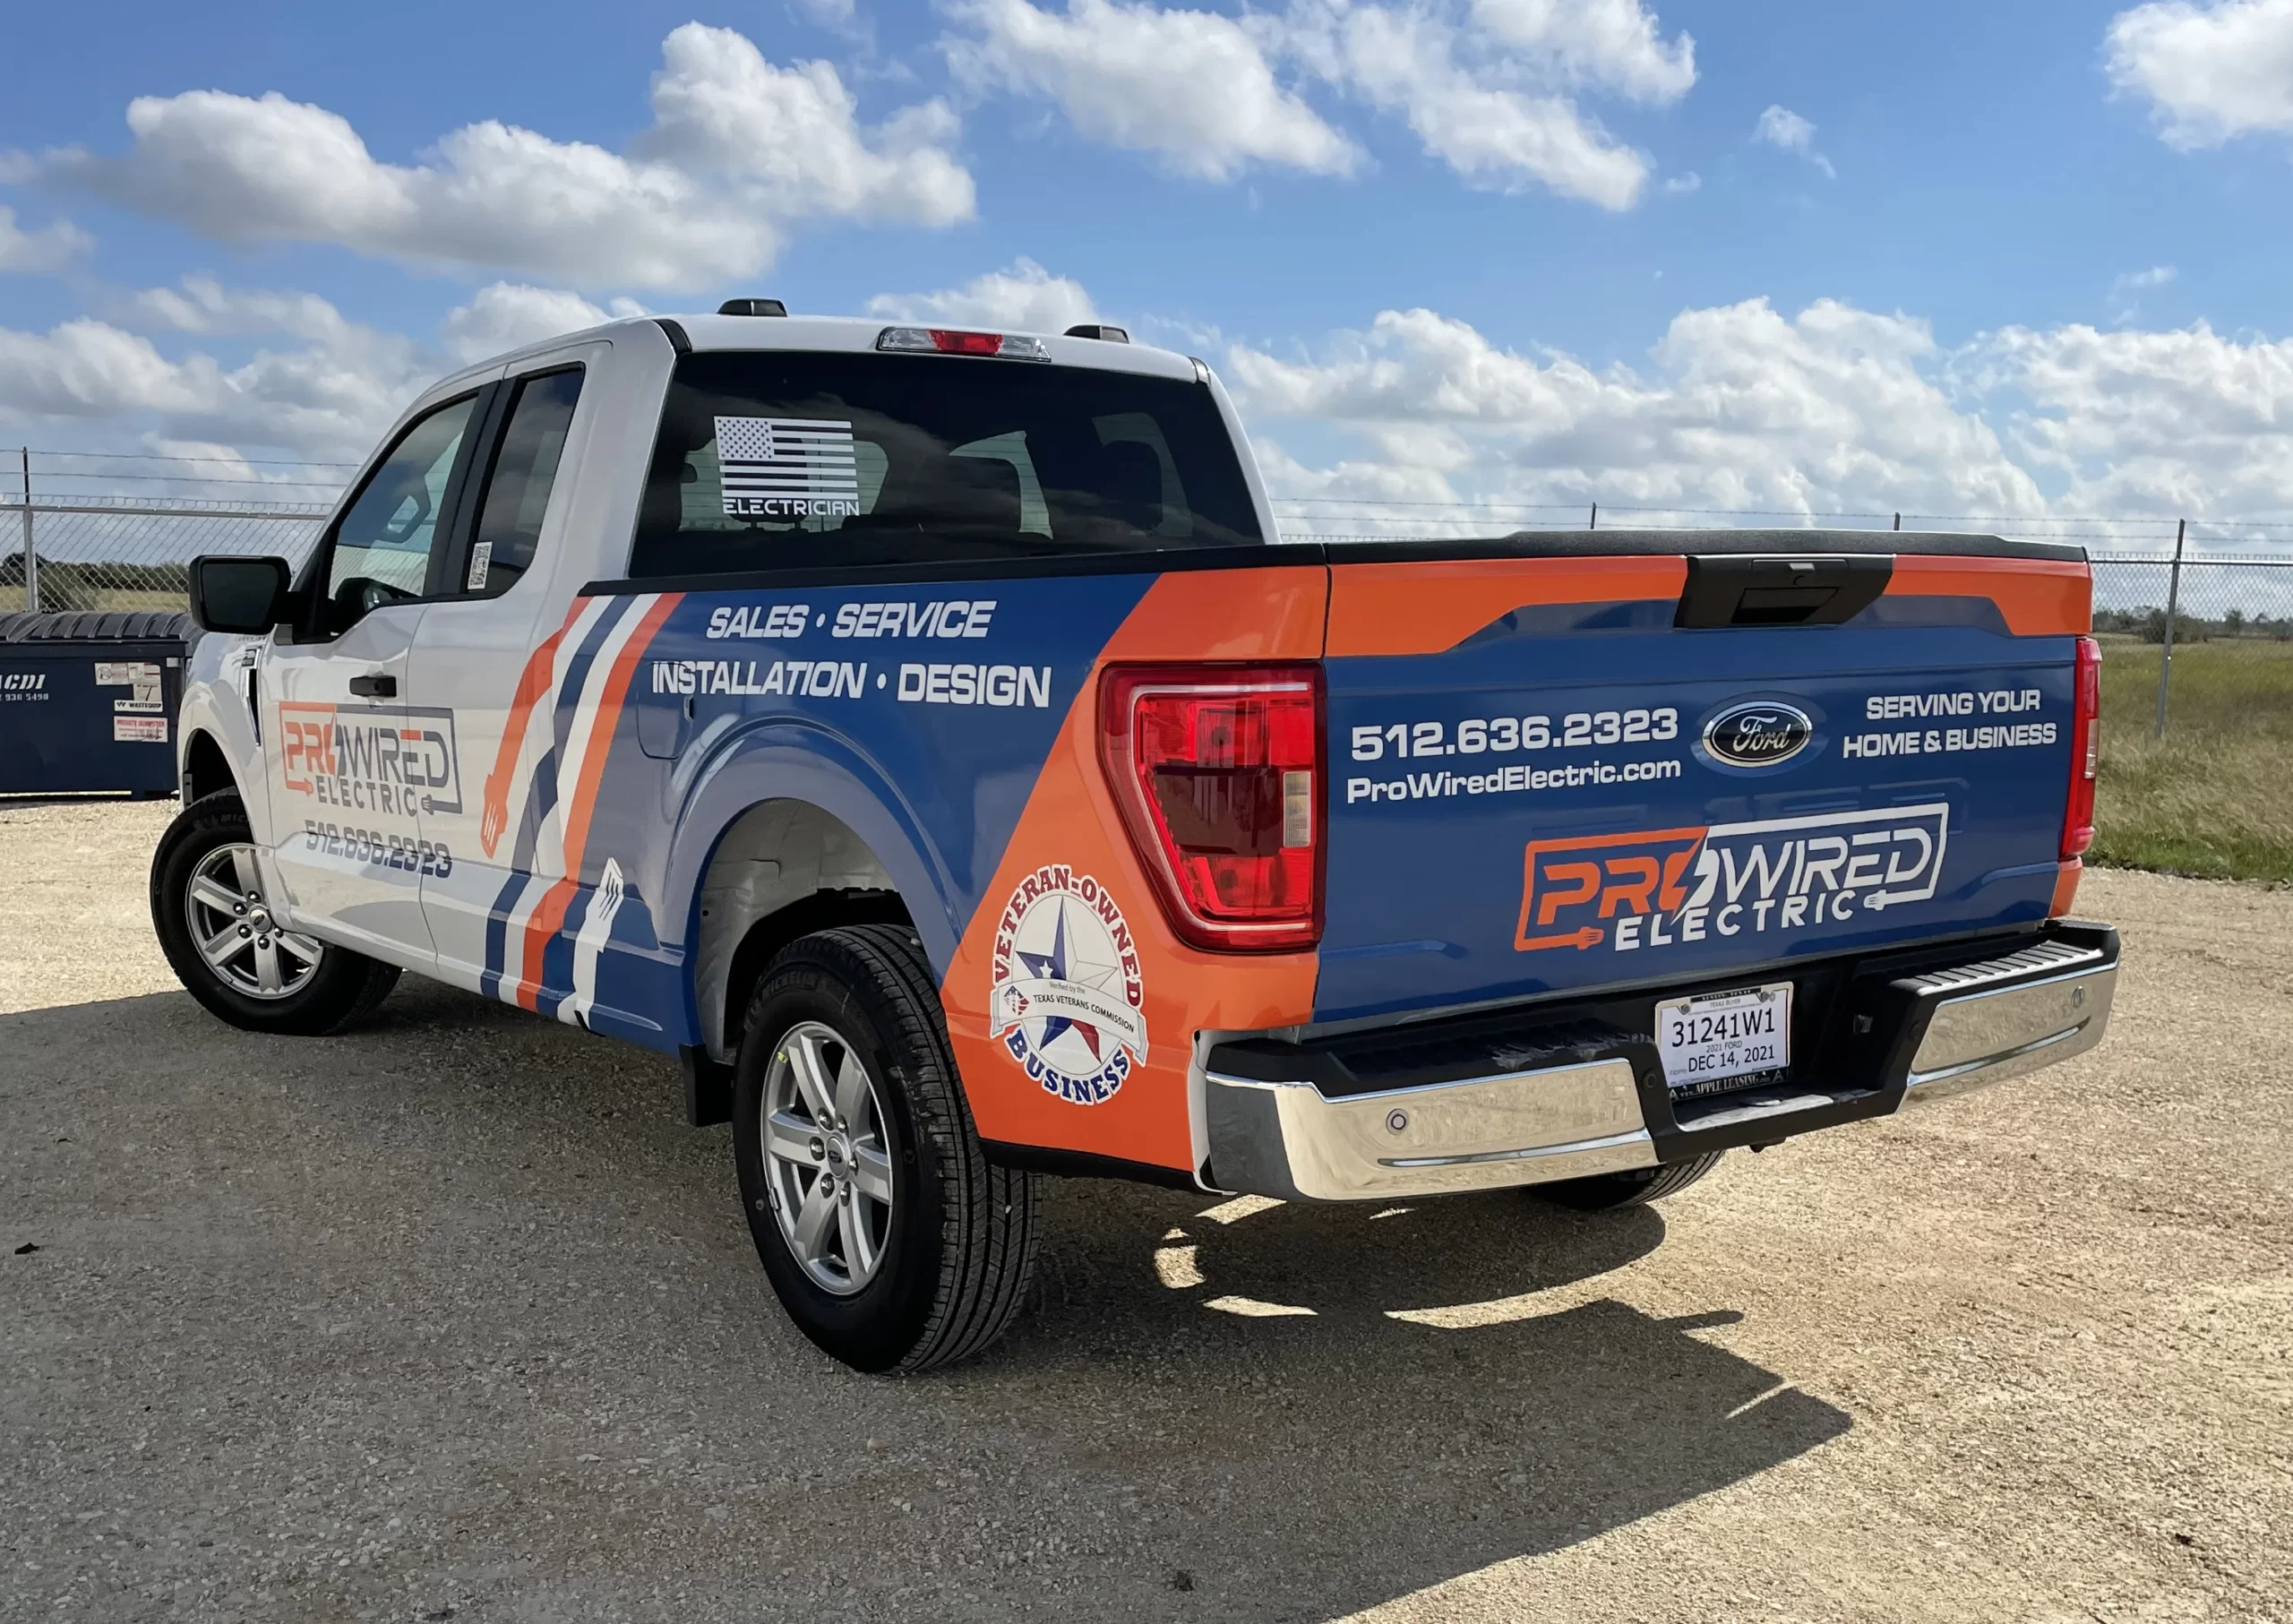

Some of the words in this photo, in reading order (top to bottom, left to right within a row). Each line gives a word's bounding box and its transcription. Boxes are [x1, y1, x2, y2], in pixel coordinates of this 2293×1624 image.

[722, 498, 860, 516] ELECTRICIAN
[707, 605, 810, 639] SALES
[831, 600, 997, 638] SERVICE
[652, 660, 868, 699] INSTALLATION
[897, 663, 1052, 708] DESIGN
[1866, 692, 1974, 720] SERVING
[1977, 689, 2041, 714] YOUR
[1351, 708, 1679, 760] 512.636.2323
[1732, 716, 1791, 753] Ford
[1842, 731, 1921, 759] HOME
[1923, 730, 1942, 752] &
[1945, 723, 2057, 751] BUSINESS
[315, 775, 417, 817] ELECTRIC
[1347, 760, 1682, 804] ProWiredElectric.com
[305, 819, 453, 878] 512.636.2323
[994, 866, 1141, 1007] VETERAN-OWNED
[1614, 889, 1856, 951] ELECTRIC
[1033, 994, 1054, 1003] TEXAS
[1056, 996, 1089, 1010] VETERANS
[1091, 1004, 1135, 1033] COMMISSION
[1671, 1008, 1775, 1048] 31241W1
[1007, 1028, 1129, 1104] BUSINESS
[1688, 1054, 1715, 1072] DEC
[1720, 1052, 1739, 1068] 14,
[1744, 1044, 1775, 1063] 2021
[1706, 1044, 1722, 1053] 2021
[1724, 1040, 1743, 1051] FORD
